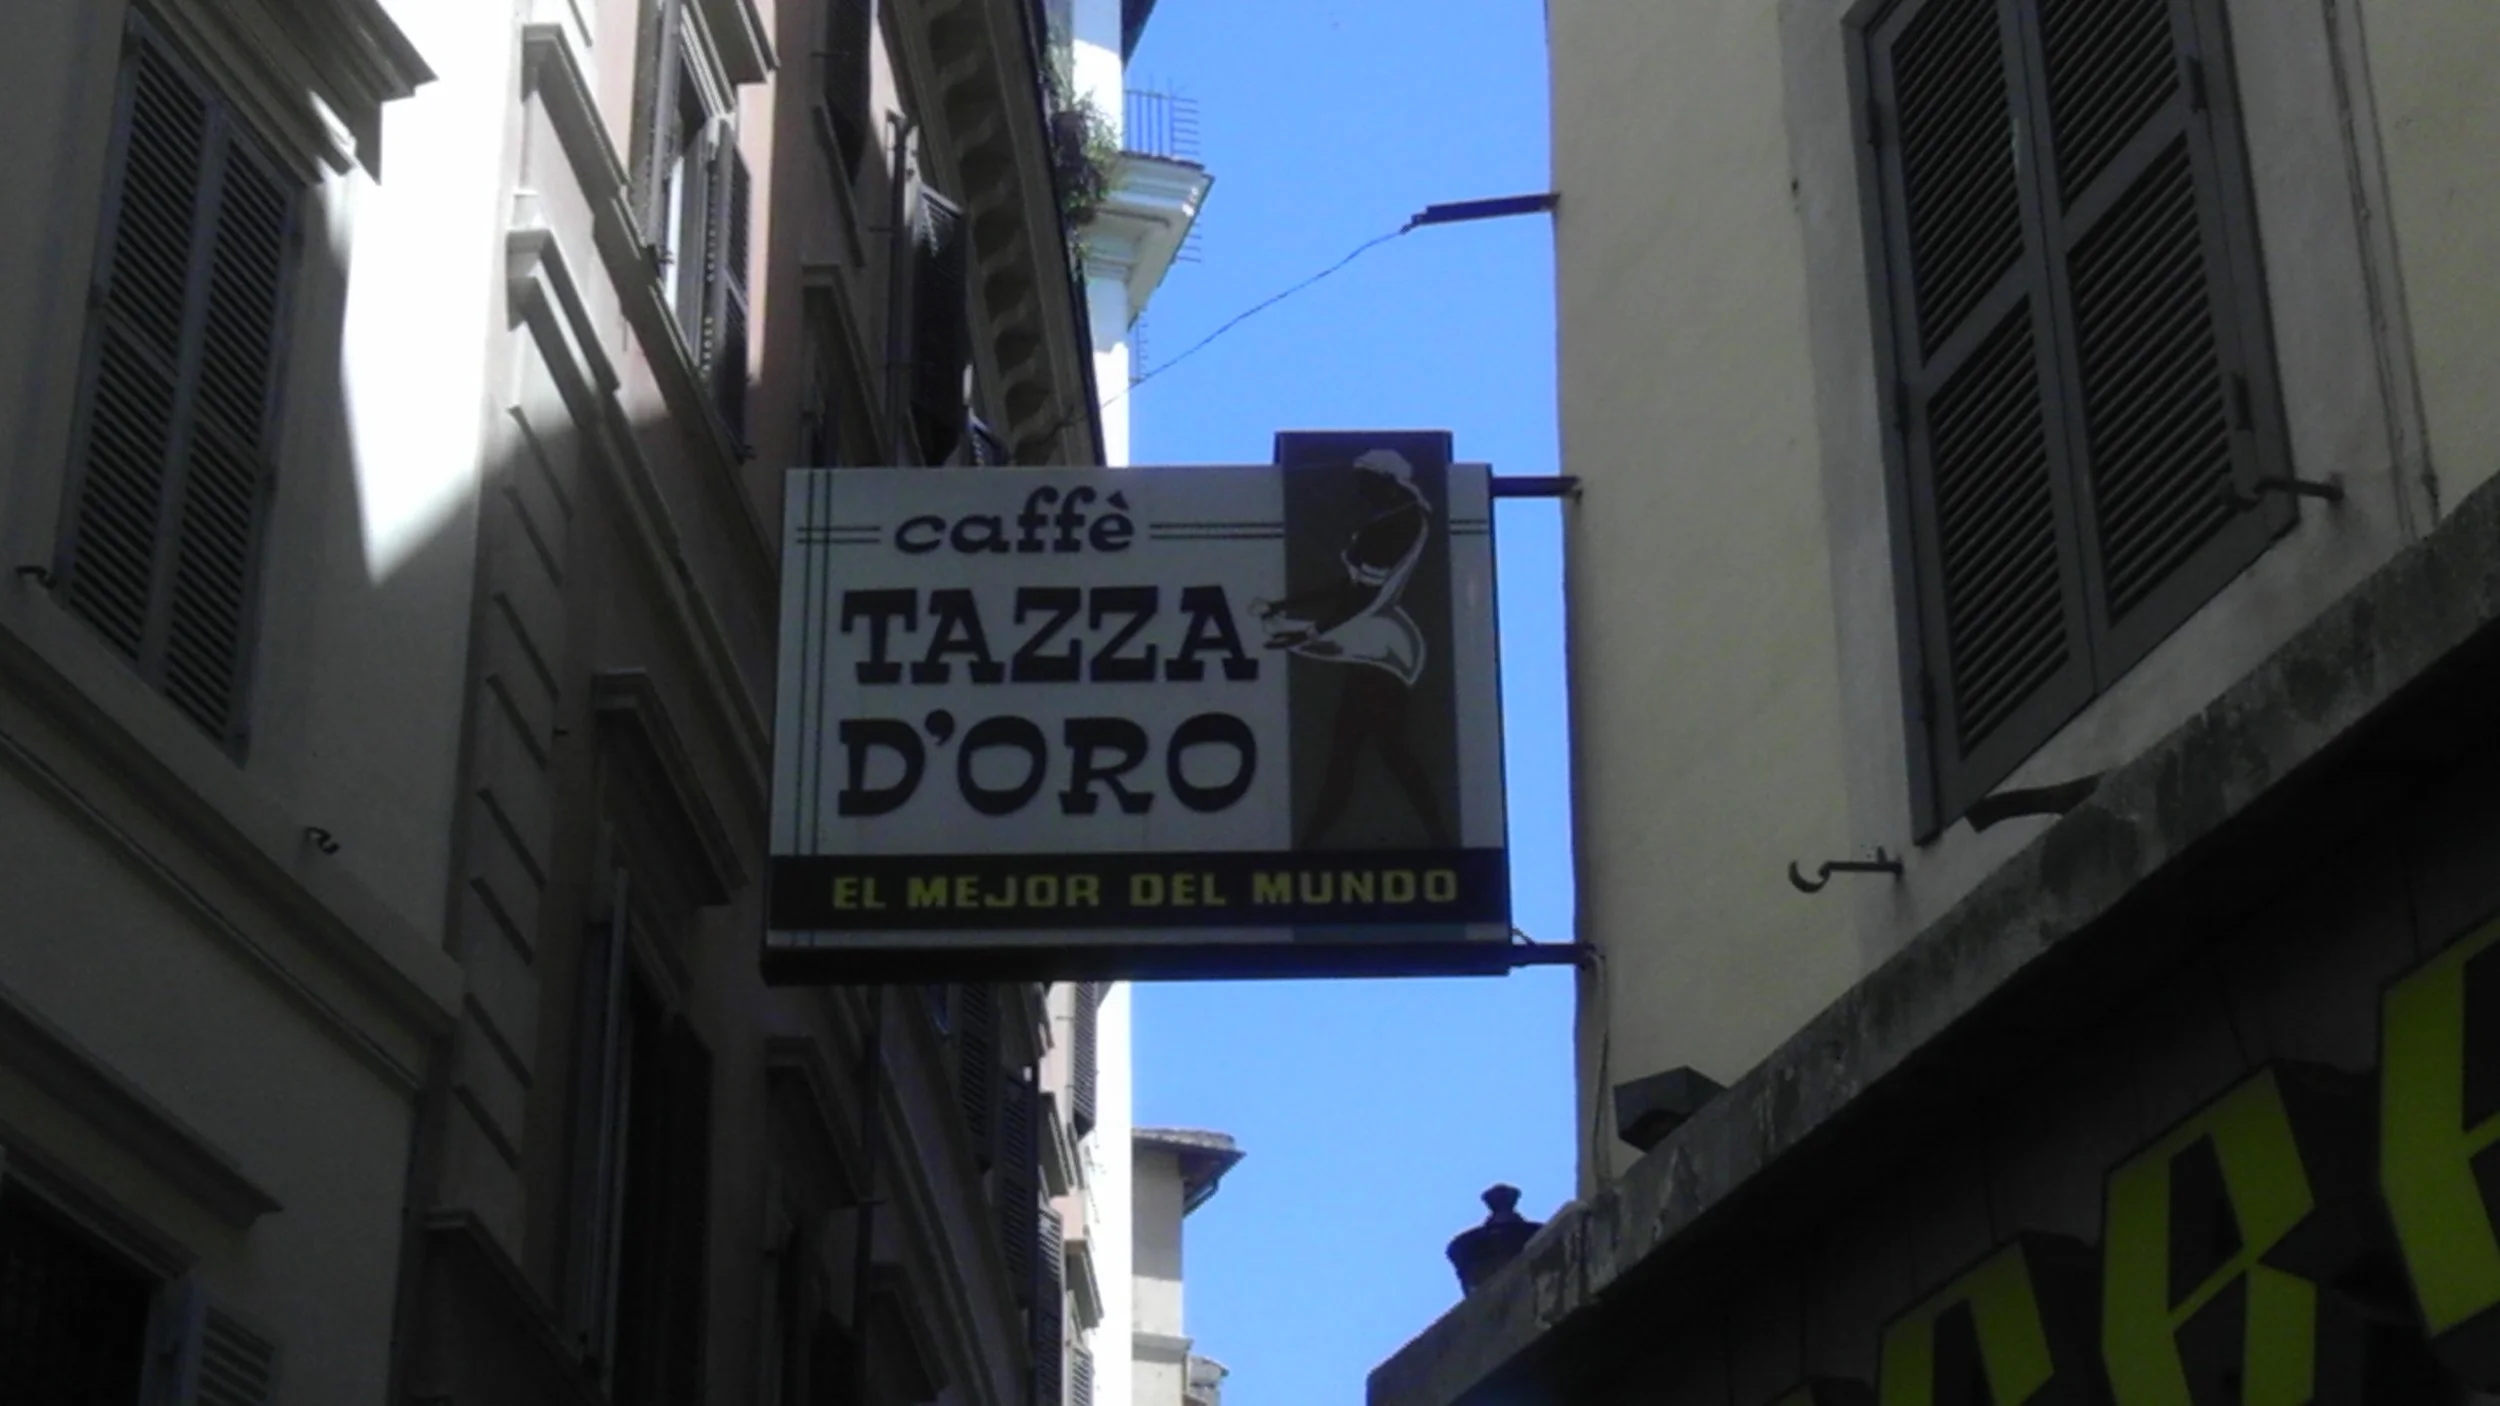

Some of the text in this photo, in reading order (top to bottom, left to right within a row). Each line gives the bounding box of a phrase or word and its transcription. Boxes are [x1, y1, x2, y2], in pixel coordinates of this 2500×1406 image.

[895, 486, 1134, 554] caffè
[841, 585, 1259, 685] TAZZA
[838, 709, 1257, 817] D'ORO
[832, 867, 1459, 910] EL MEJOR DEL MUNDO
